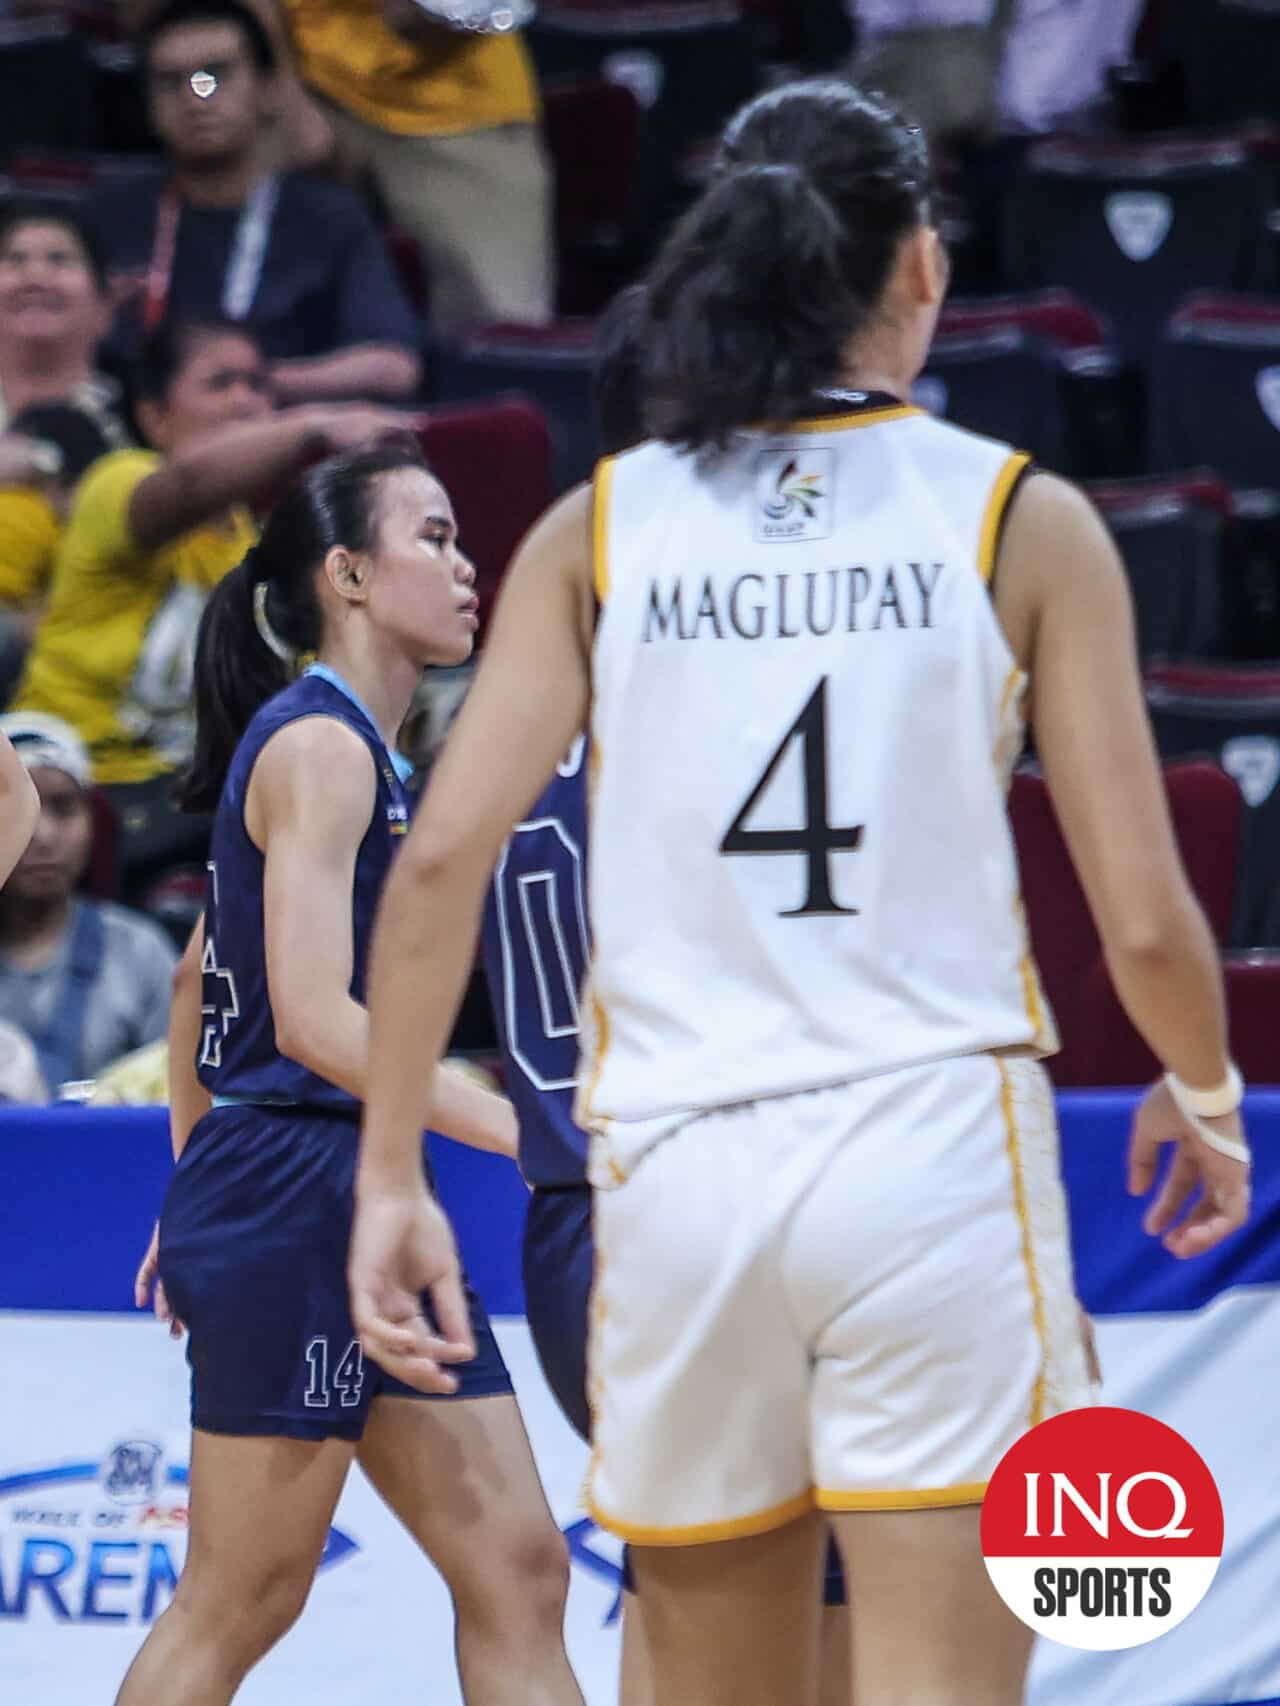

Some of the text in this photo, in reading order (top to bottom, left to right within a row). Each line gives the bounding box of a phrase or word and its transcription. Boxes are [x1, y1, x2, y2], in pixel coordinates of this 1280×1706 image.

[644, 562, 946, 643] MAGLUPAY
[717, 674, 865, 919] 4
[304, 1338, 365, 1408] 14
